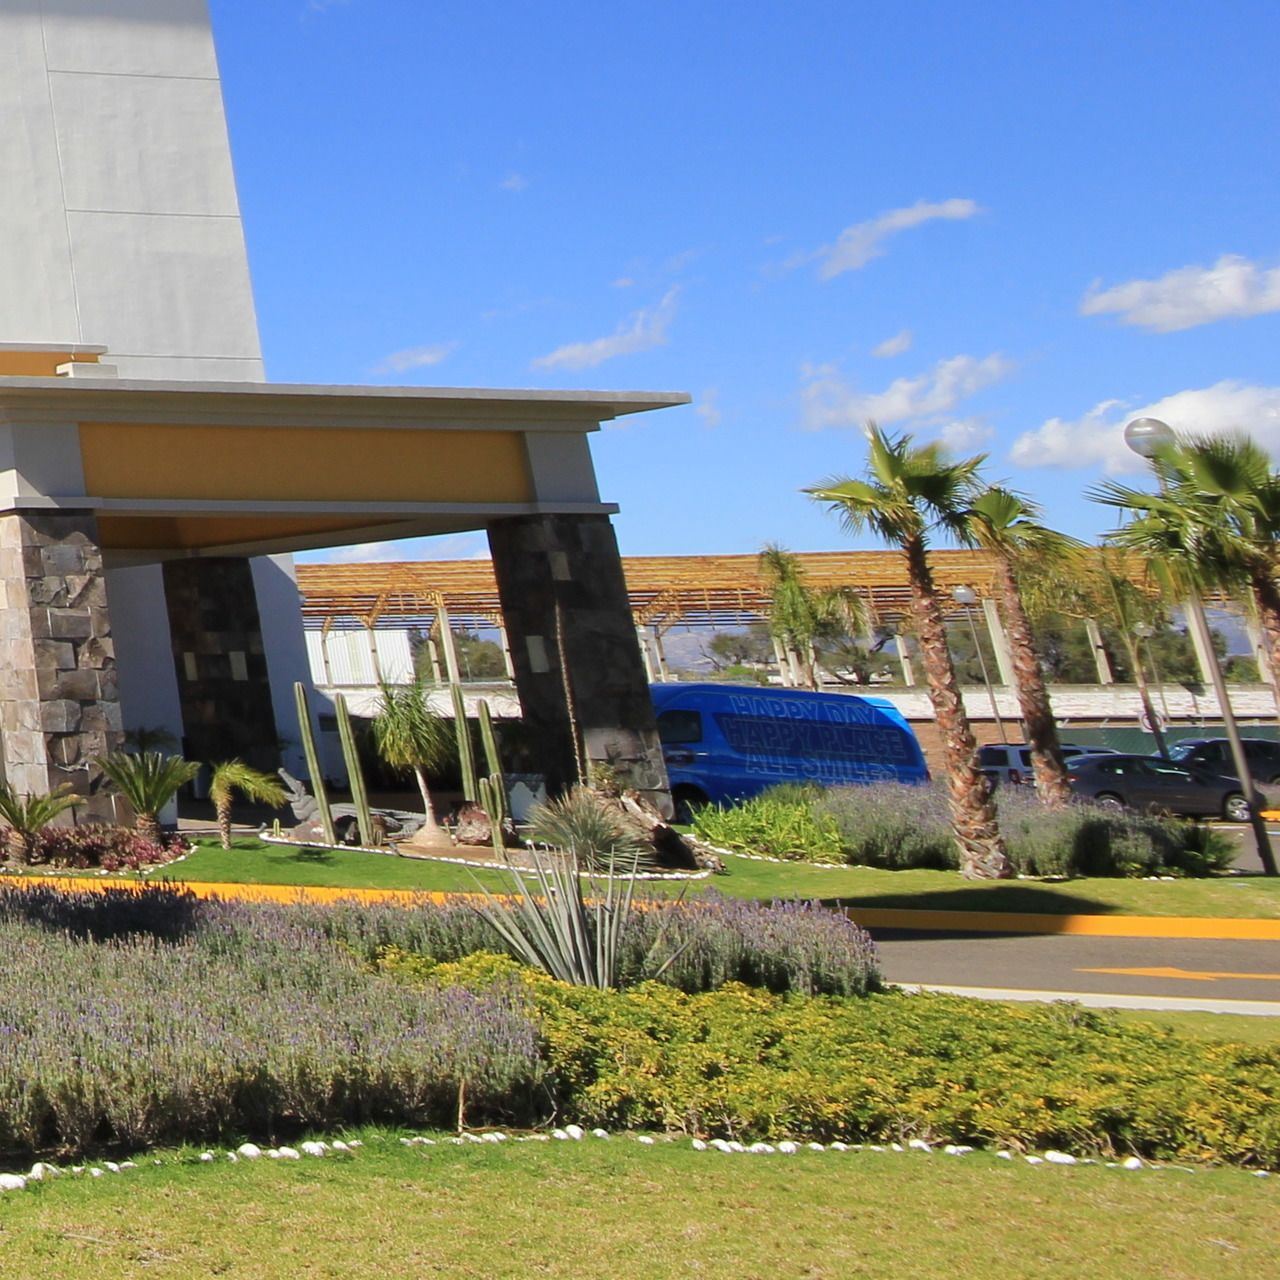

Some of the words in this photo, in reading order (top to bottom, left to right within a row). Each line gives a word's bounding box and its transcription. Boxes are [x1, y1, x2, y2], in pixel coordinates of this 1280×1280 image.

[729, 695, 819, 723] HAPPY
[824, 702, 878, 728] DAY
[719, 717, 816, 753] HAPPY
[817, 723, 907, 759] PLACE
[745, 748, 798, 777] ALL
[801, 752, 899, 782] SMILES
